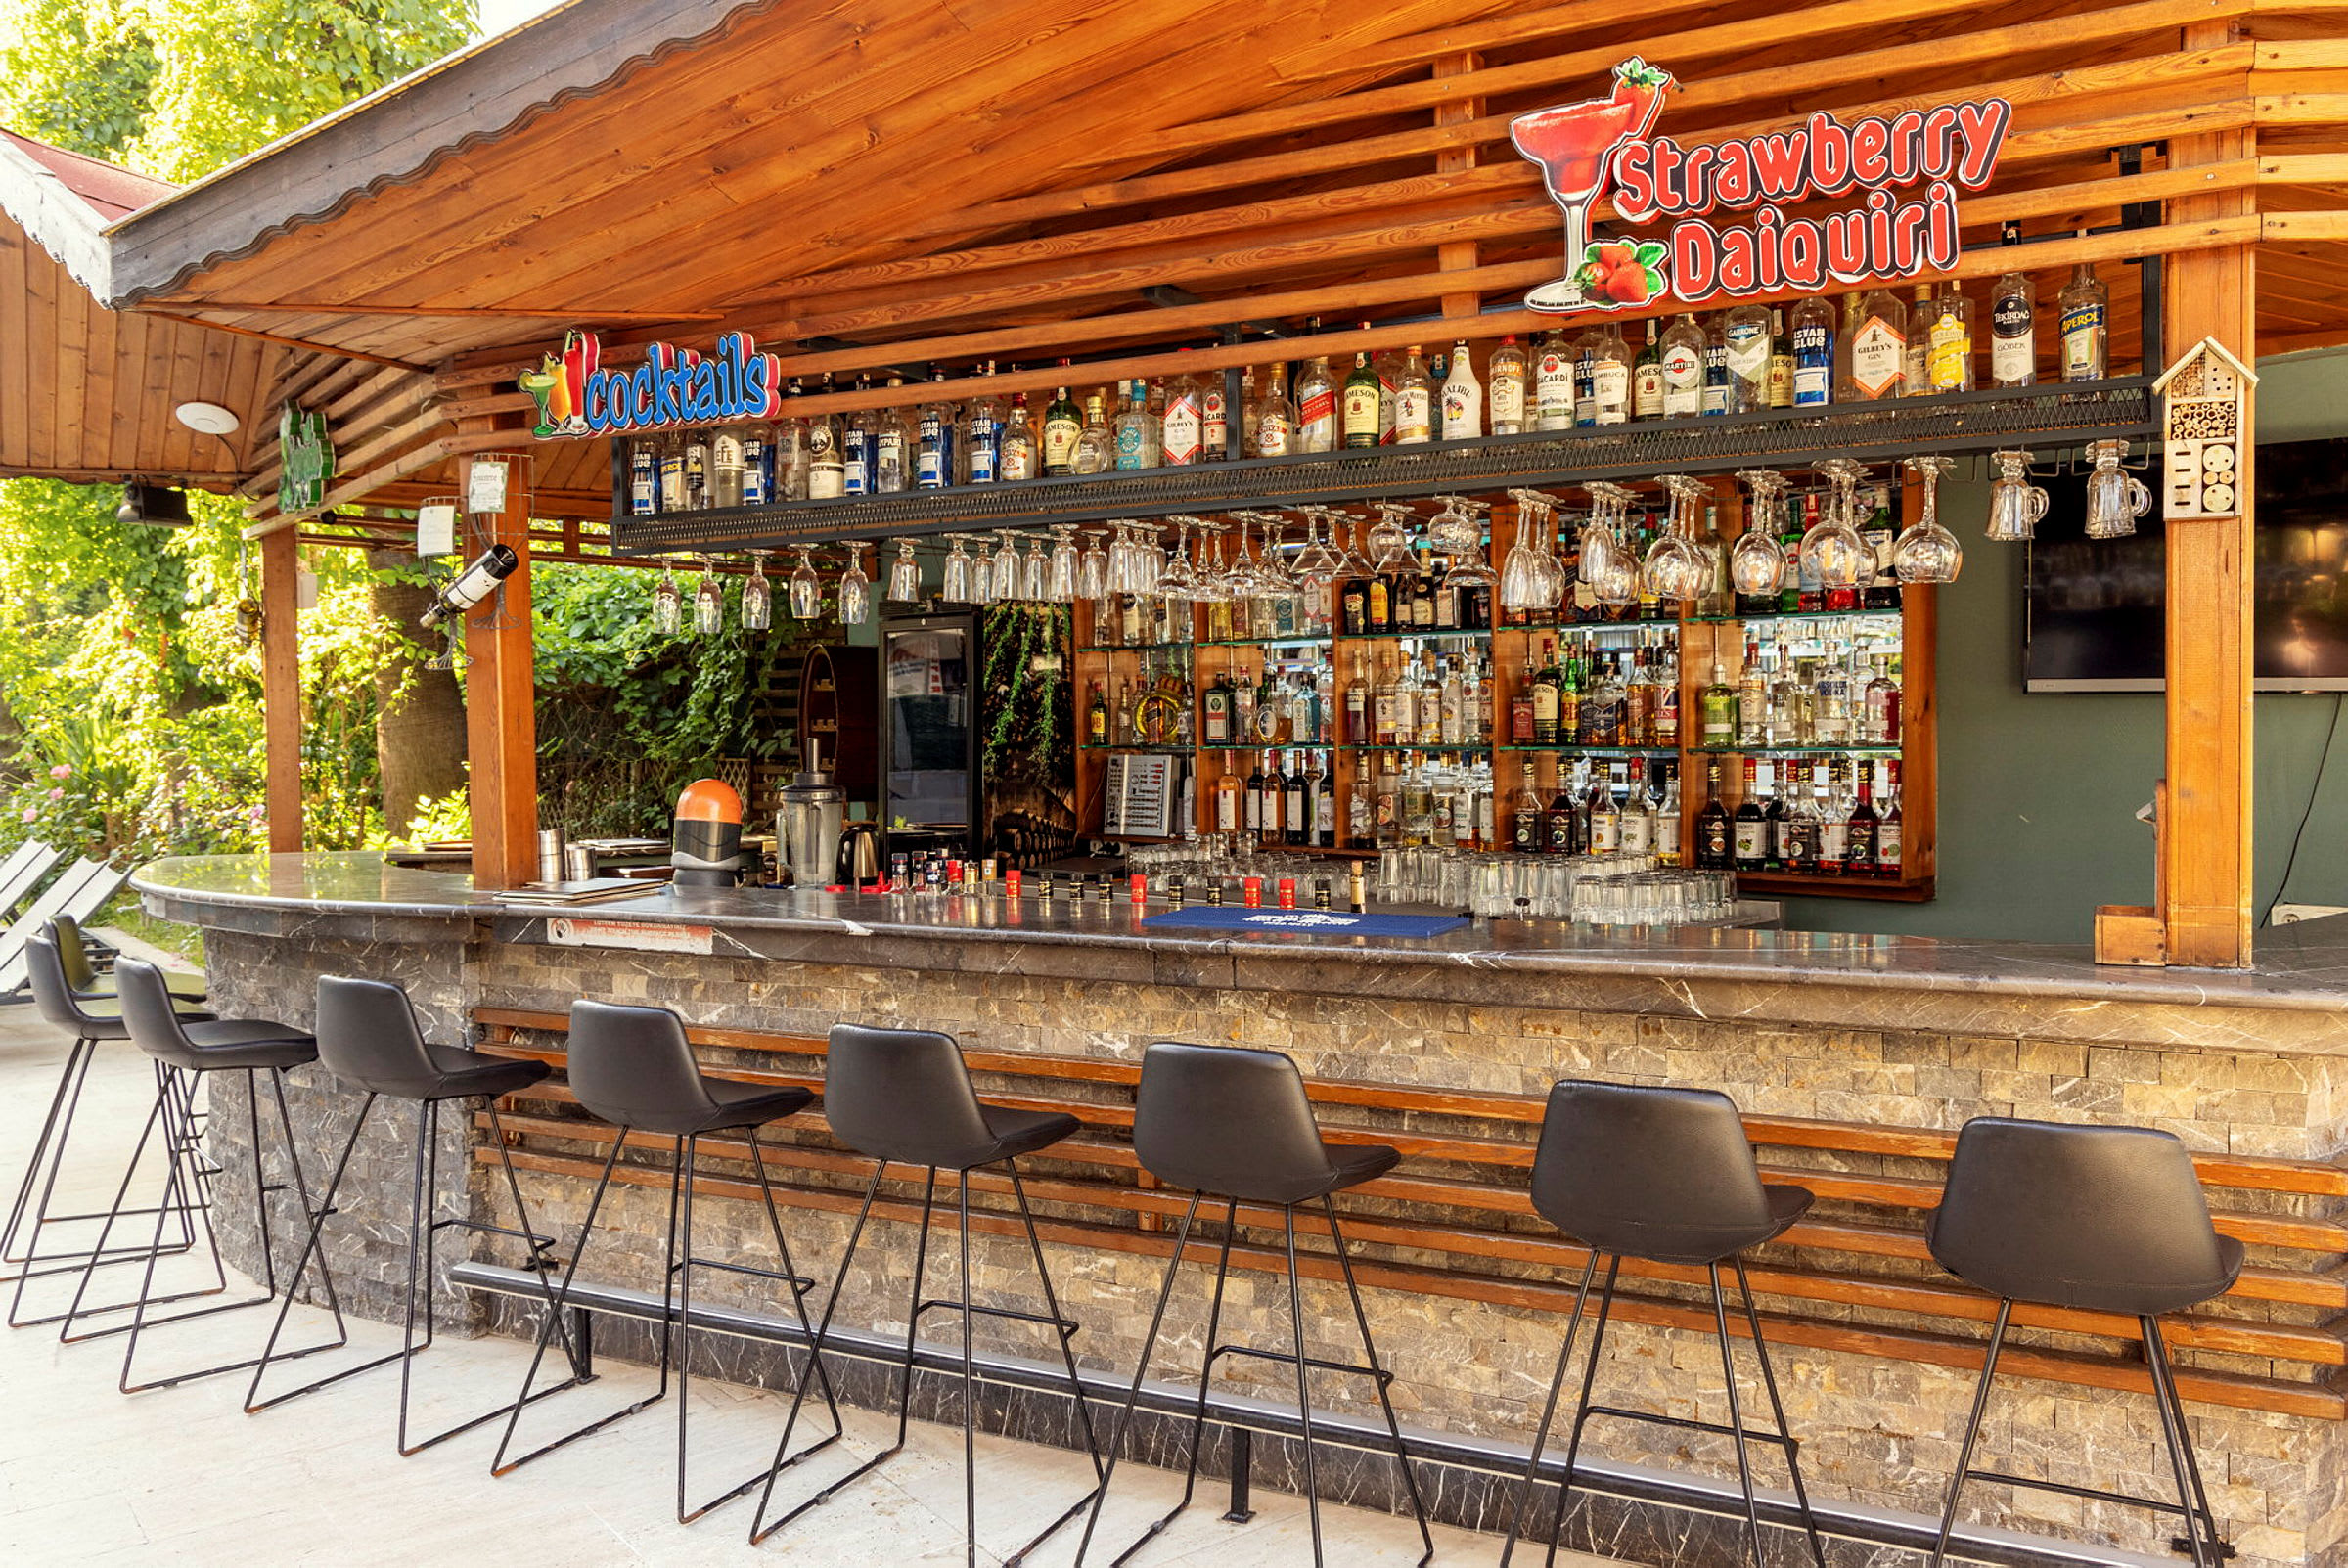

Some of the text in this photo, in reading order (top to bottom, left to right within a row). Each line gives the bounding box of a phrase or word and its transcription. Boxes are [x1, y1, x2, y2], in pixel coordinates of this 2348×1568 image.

[1617, 100, 2006, 217] Strawberry
[1674, 181, 1950, 296] Daiquiri
[2061, 311, 2100, 333] APEROL
[1664, 360, 1695, 372] MARTINI
